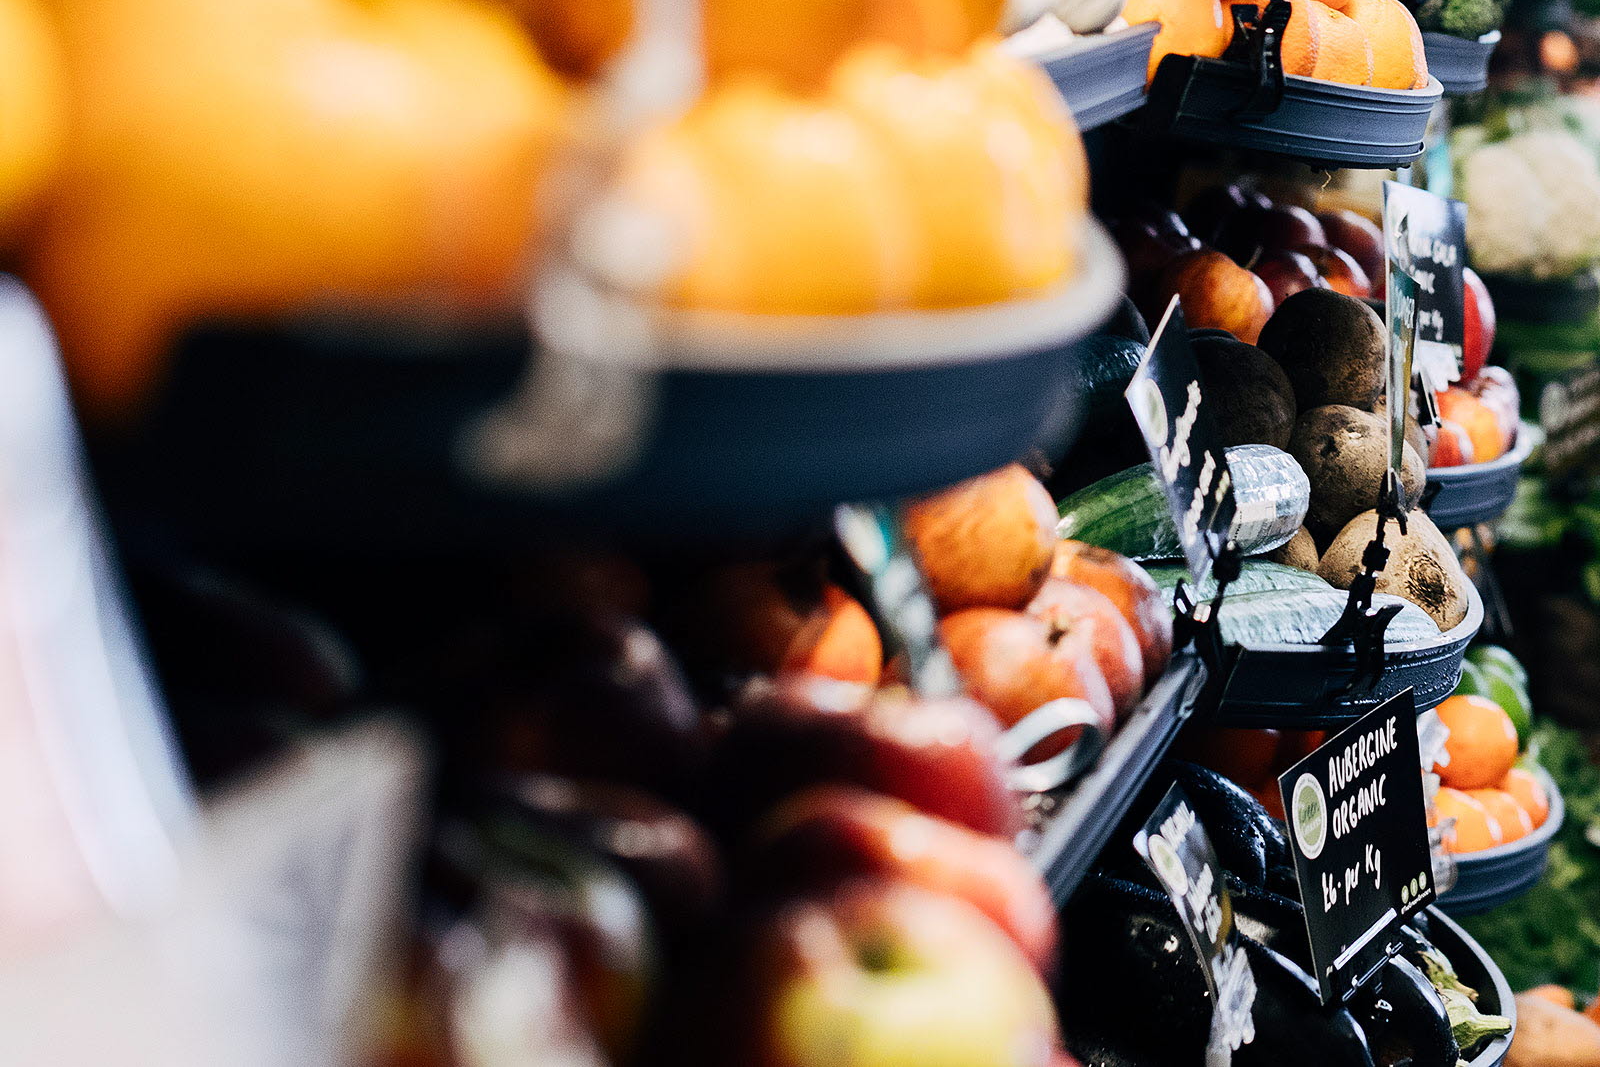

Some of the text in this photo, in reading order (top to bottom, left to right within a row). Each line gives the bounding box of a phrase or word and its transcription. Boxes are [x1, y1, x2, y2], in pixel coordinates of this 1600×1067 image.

[1328, 715, 1398, 798] AUBERGINE
[1332, 773, 1387, 840] ORGANIC
[1345, 861, 1360, 905] per
